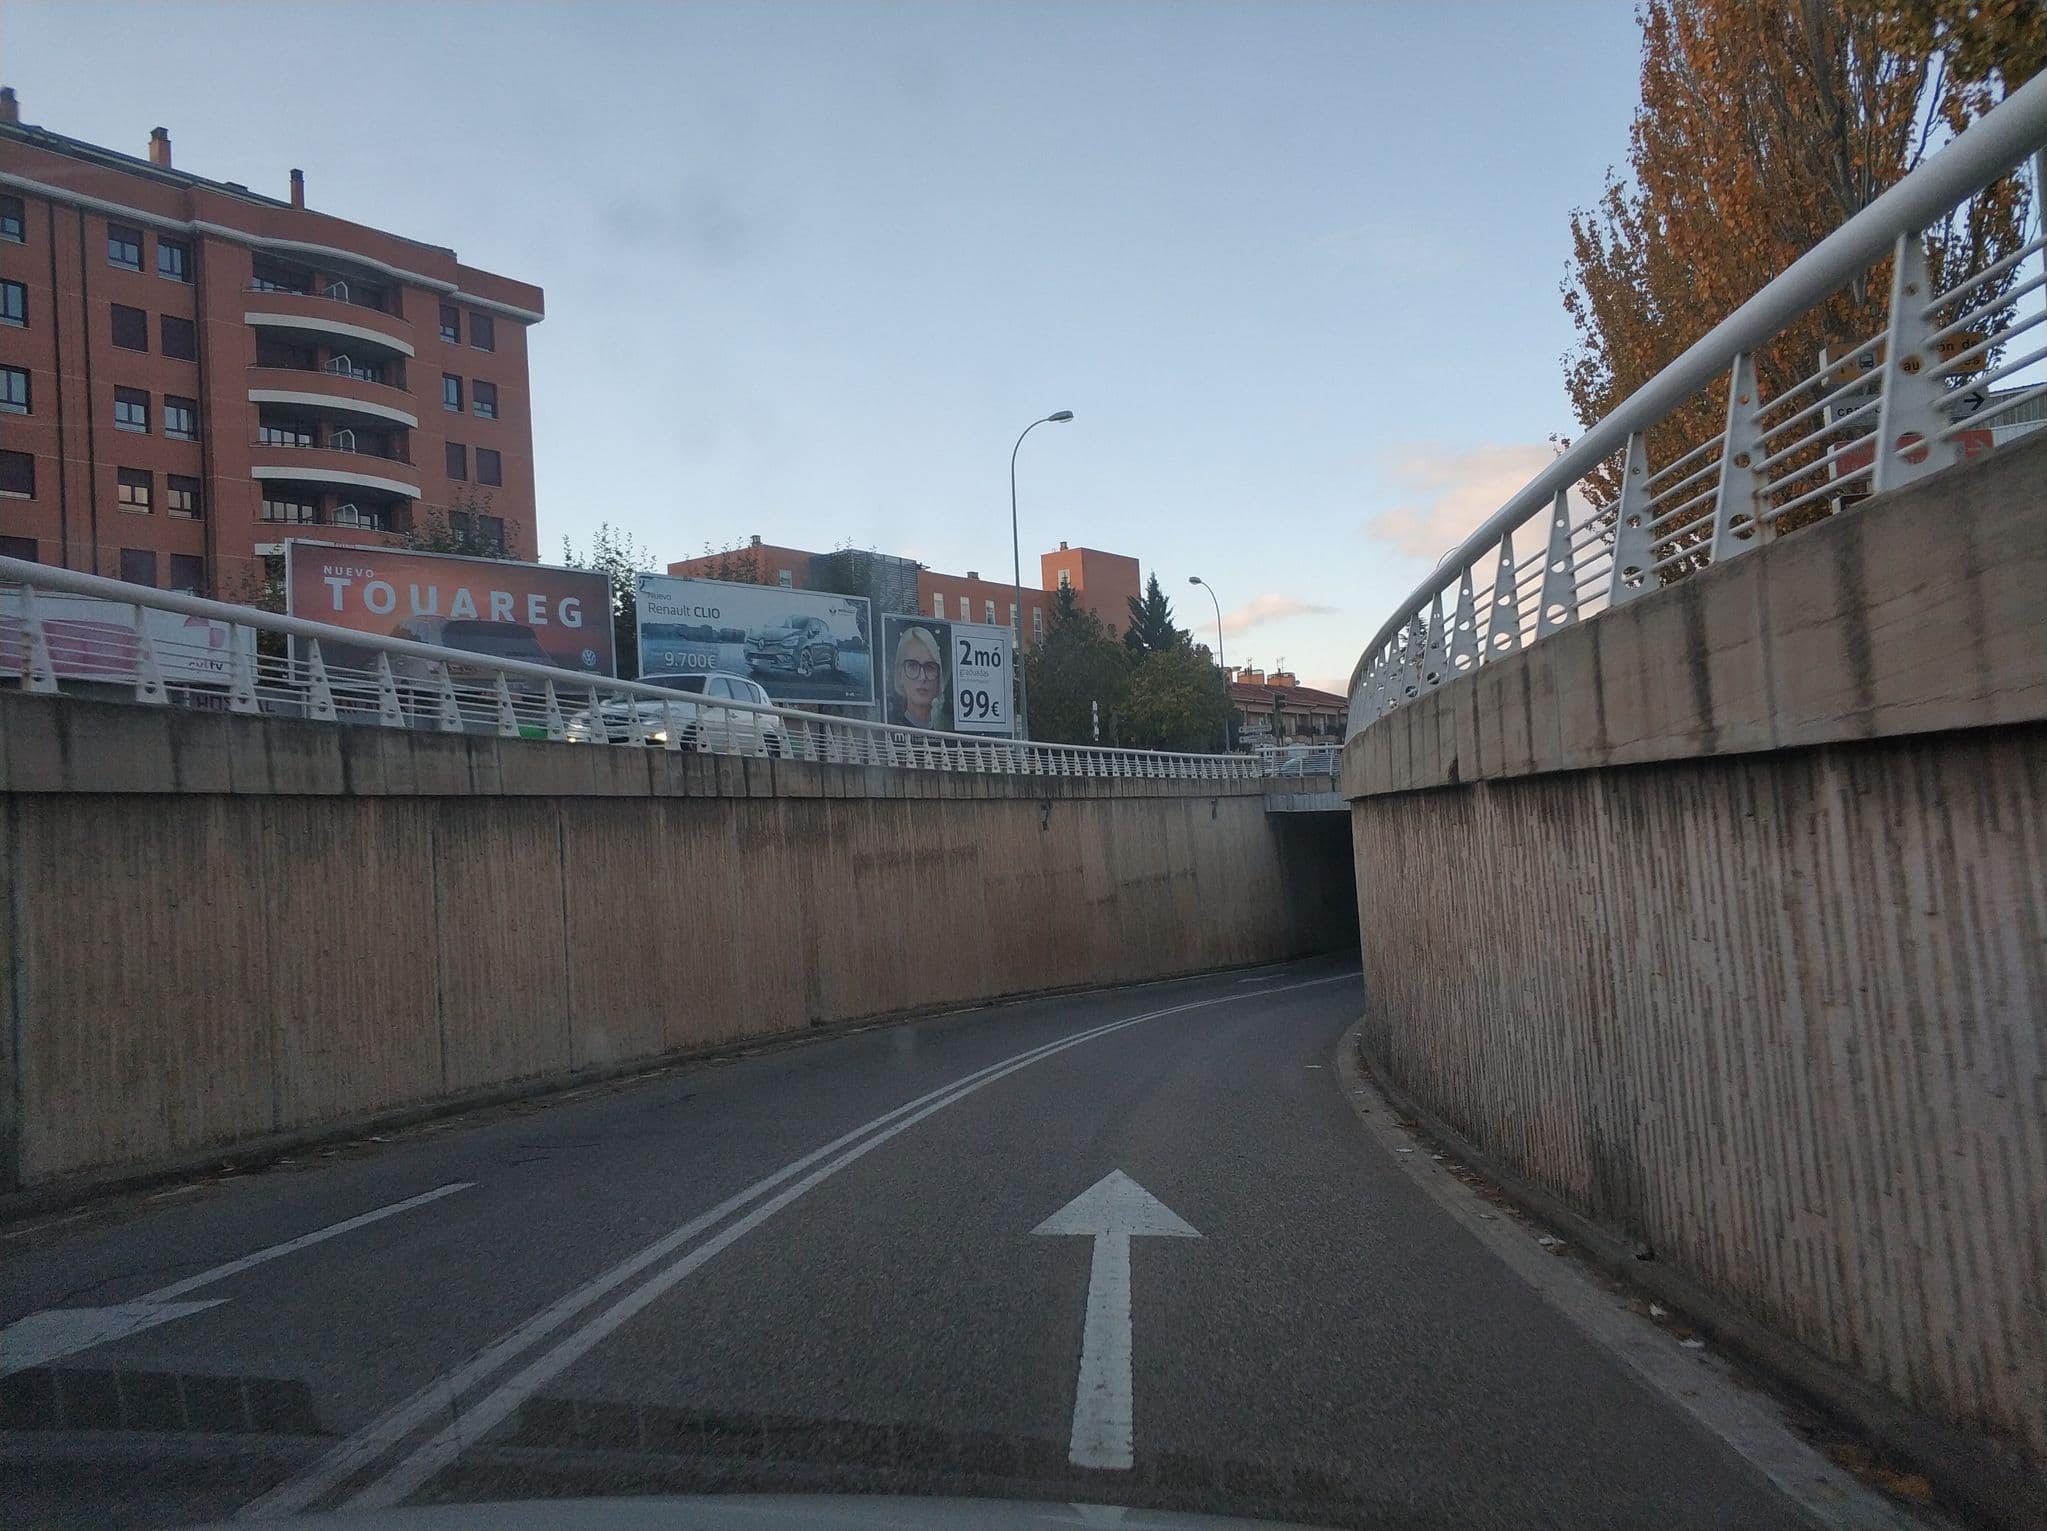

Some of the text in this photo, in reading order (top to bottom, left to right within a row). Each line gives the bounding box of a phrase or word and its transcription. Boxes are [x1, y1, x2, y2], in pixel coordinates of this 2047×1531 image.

[323, 565, 375, 578] NUEVO
[323, 577, 583, 629] TOUAREG
[648, 602, 721, 619] Renault CLIO
[664, 651, 717, 669] 9.700€
[959, 689, 1000, 718] 99€
